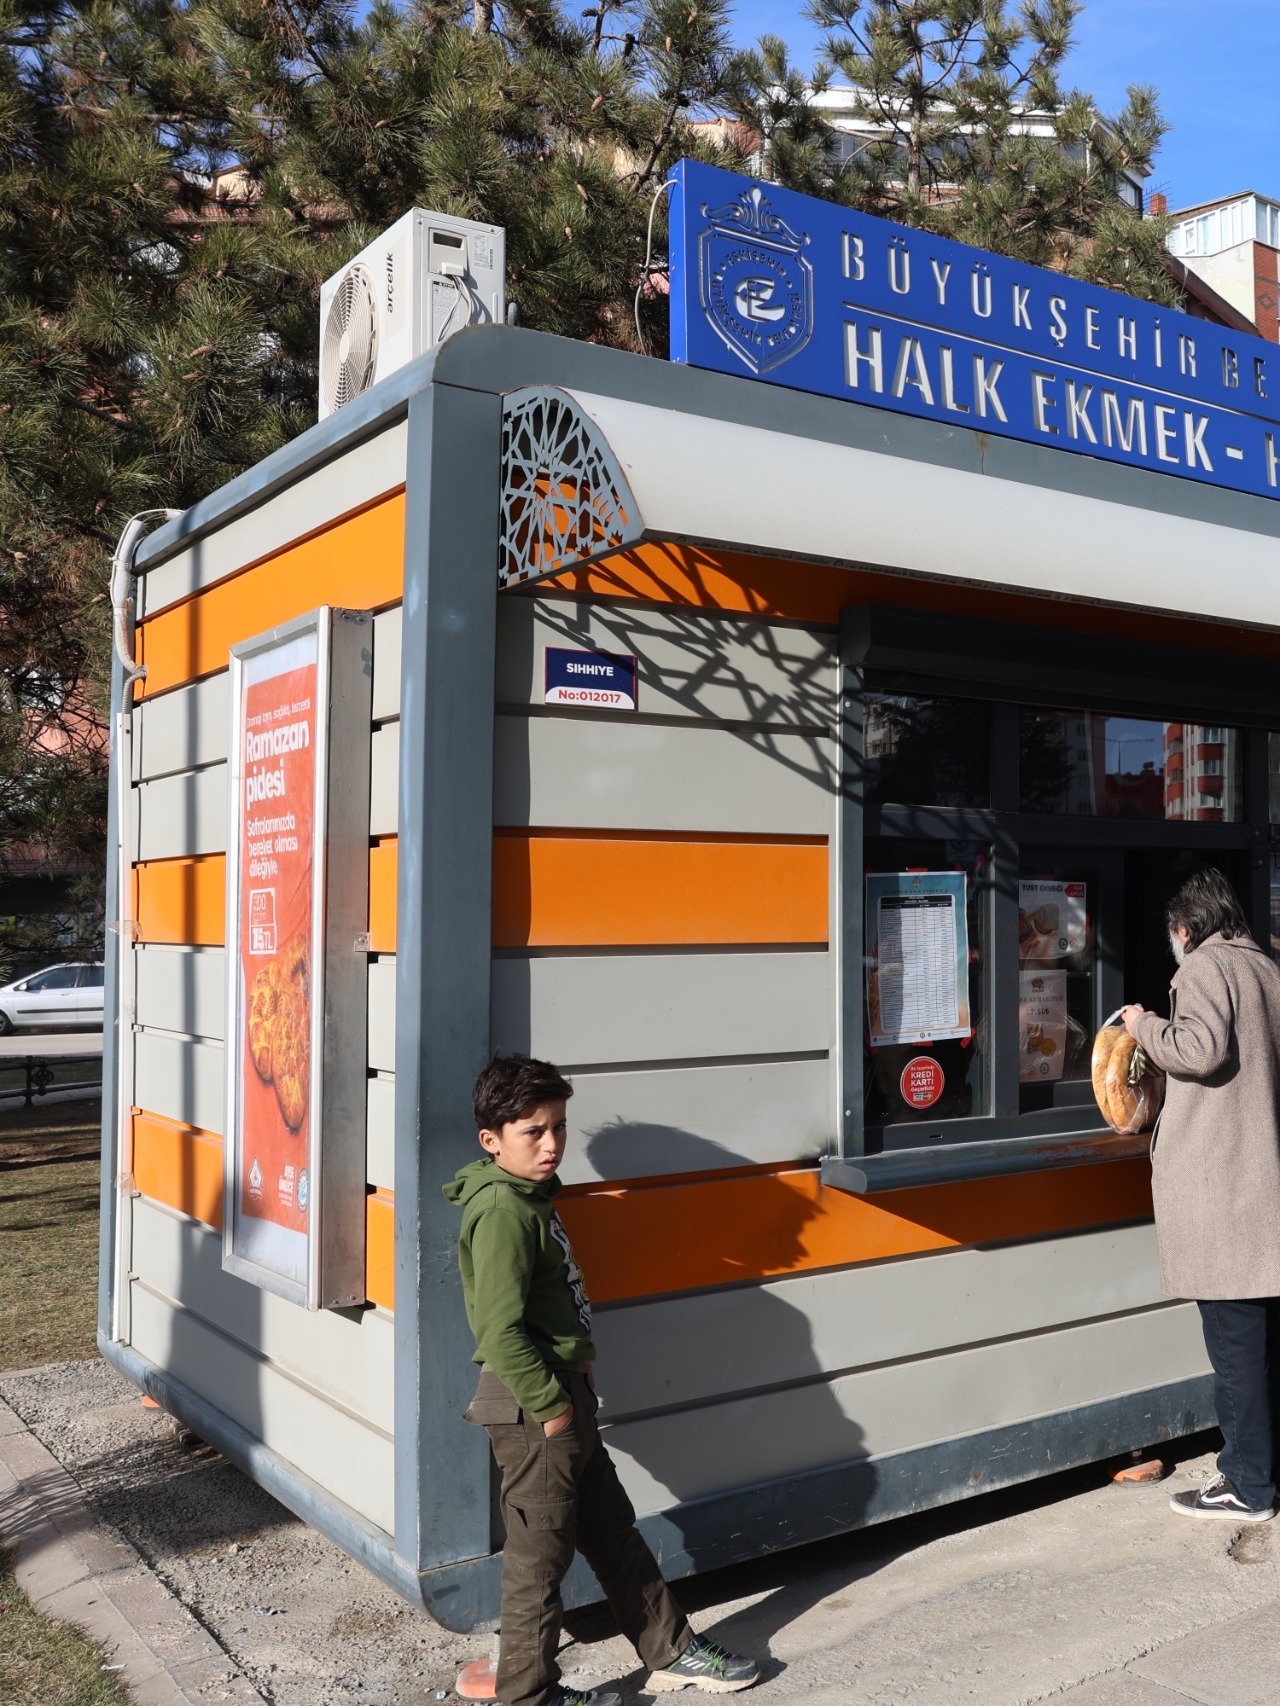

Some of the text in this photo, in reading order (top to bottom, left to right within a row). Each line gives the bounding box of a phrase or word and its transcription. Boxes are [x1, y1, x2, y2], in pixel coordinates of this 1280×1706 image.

[386, 252, 394, 313] arçelik
[840, 231, 1197, 378] BÜYÜKŞEHİR
[843, 319, 1009, 423] HALK
[1031, 369, 1215, 473] EKMEK
[558, 689, 621, 703] No:012017
[246, 720, 310, 764] Ramazan
[246, 758, 286, 811] pidesi
[274, 835, 298, 853] olması
[1022, 884, 1038, 892] TOST
[253, 894, 267, 911] 300
[911, 1069, 934, 1079] KREDİ
[911, 1078, 934, 1087] KARTI
